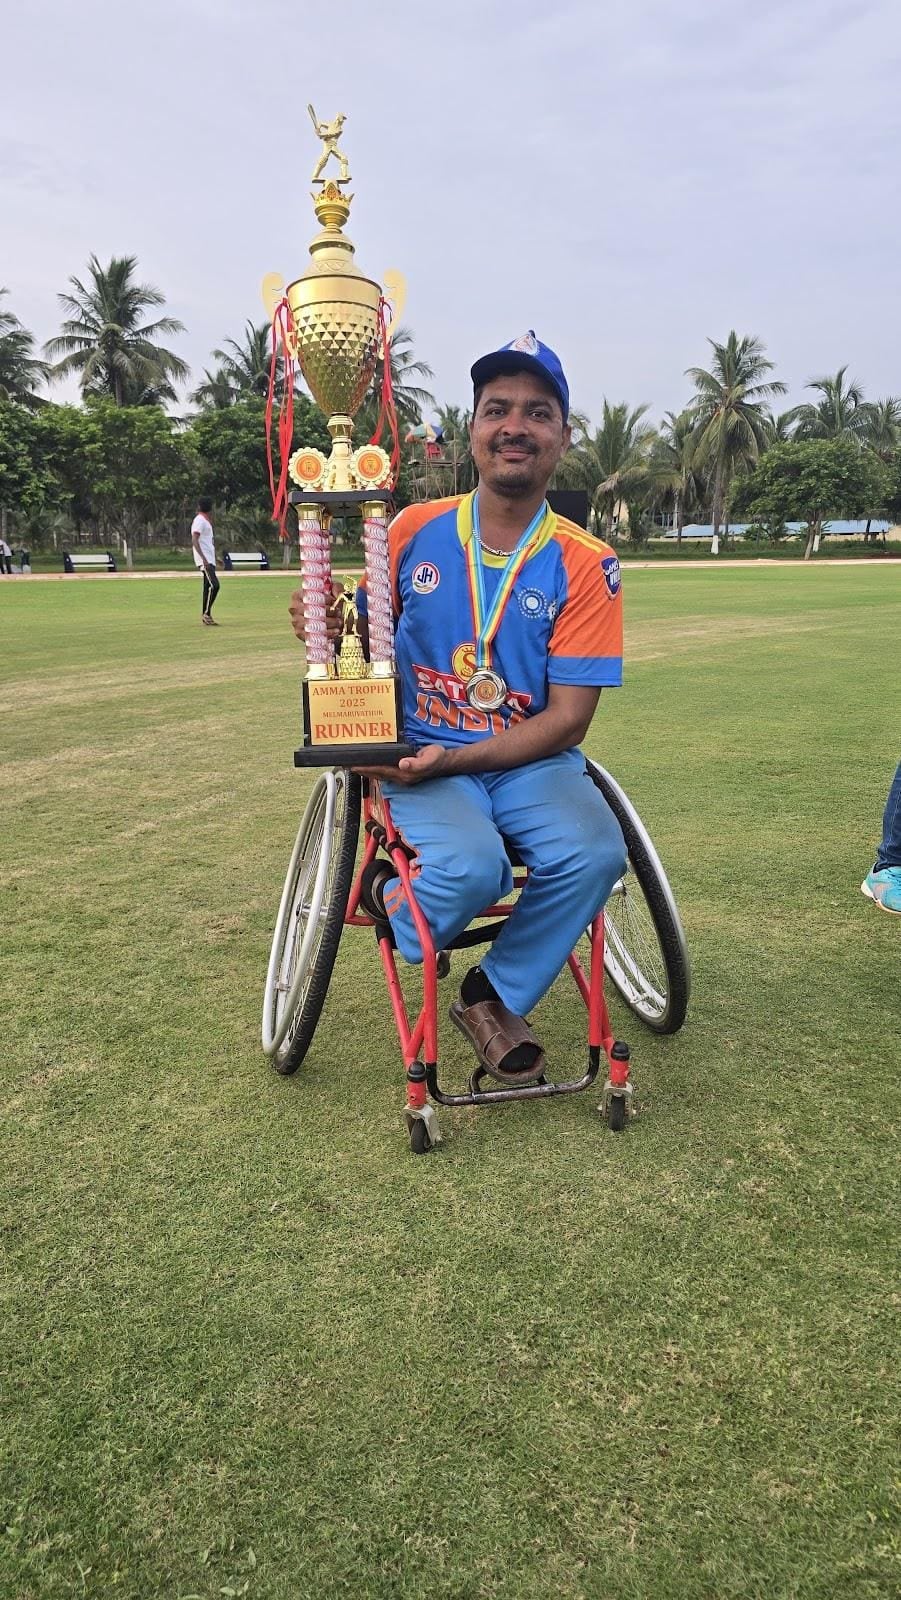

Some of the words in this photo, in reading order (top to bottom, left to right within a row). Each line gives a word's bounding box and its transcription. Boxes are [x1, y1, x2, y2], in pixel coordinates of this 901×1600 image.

[312, 686, 346, 696] AMMA
[347, 684, 392, 695] TROPHY
[417, 672, 525, 713] SATA
[339, 698, 366, 708] 2025
[315, 722, 393, 739] RUNNER
